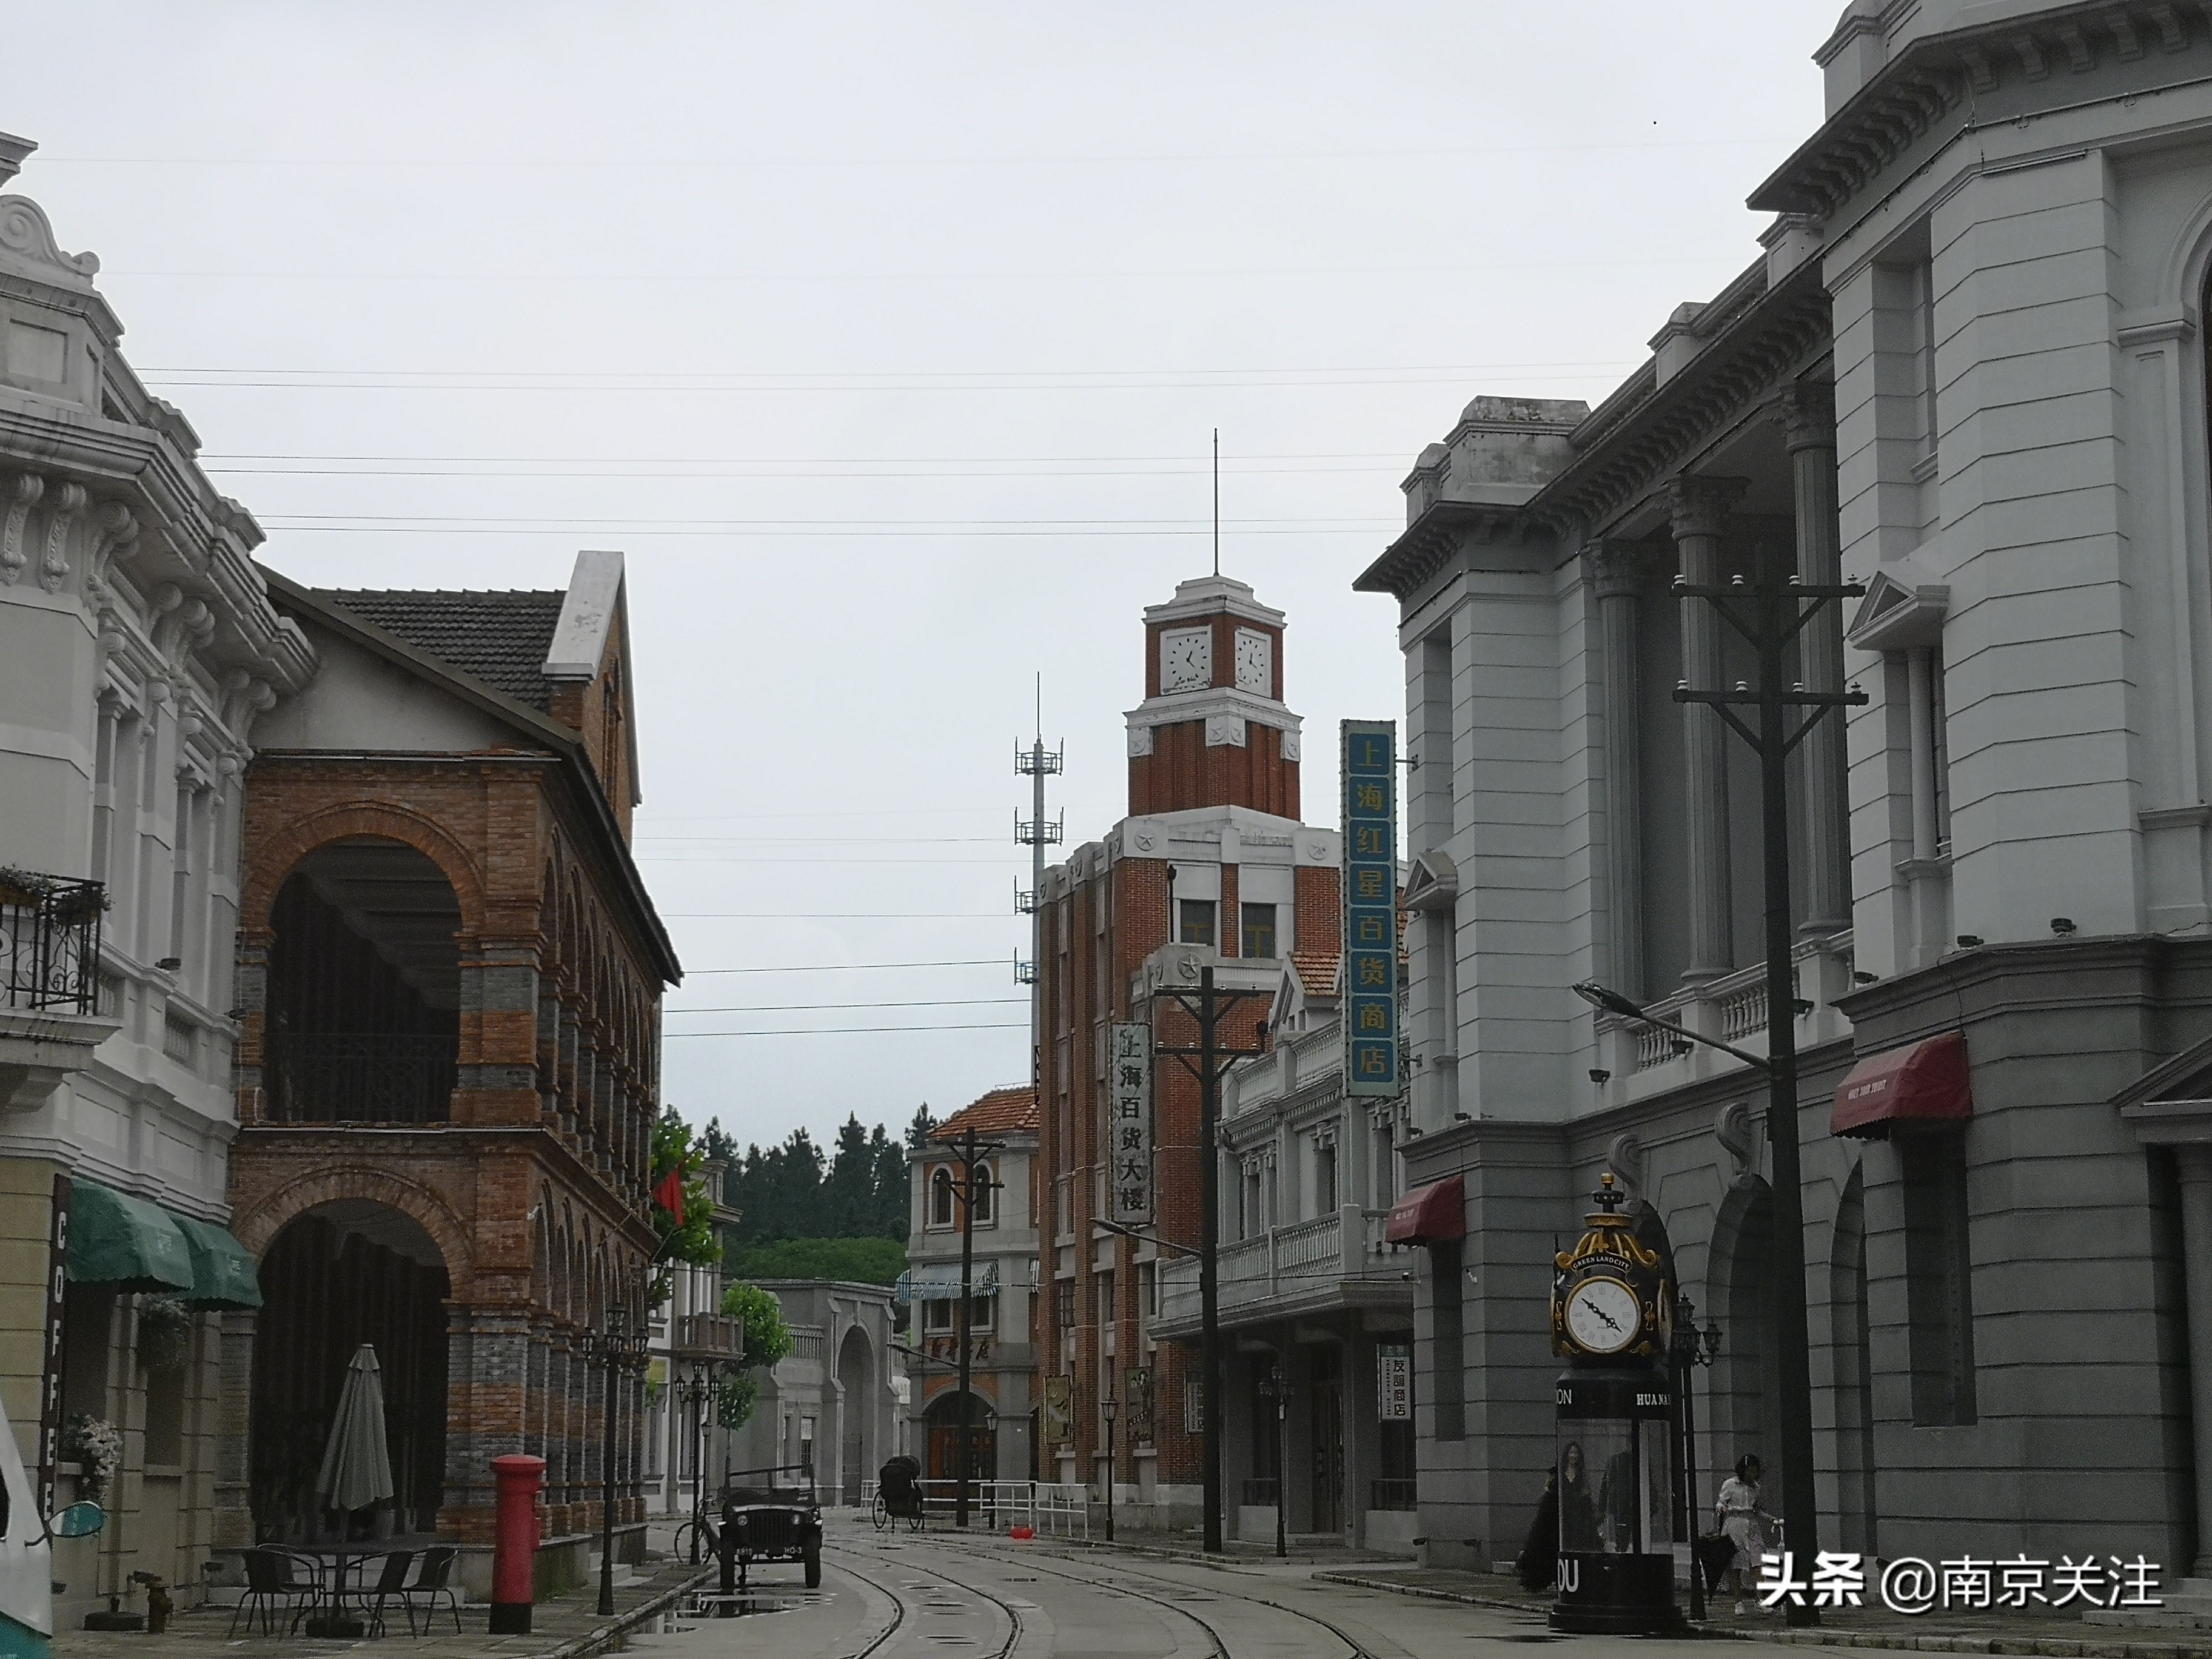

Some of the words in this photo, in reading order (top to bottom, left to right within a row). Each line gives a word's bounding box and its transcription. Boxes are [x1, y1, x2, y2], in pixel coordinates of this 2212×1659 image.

[1356, 741, 1387, 1074] 上海红星百货商店
[44, 1212, 66, 1521] COFFEE
[1573, 1256, 1595, 1269] GREEN
